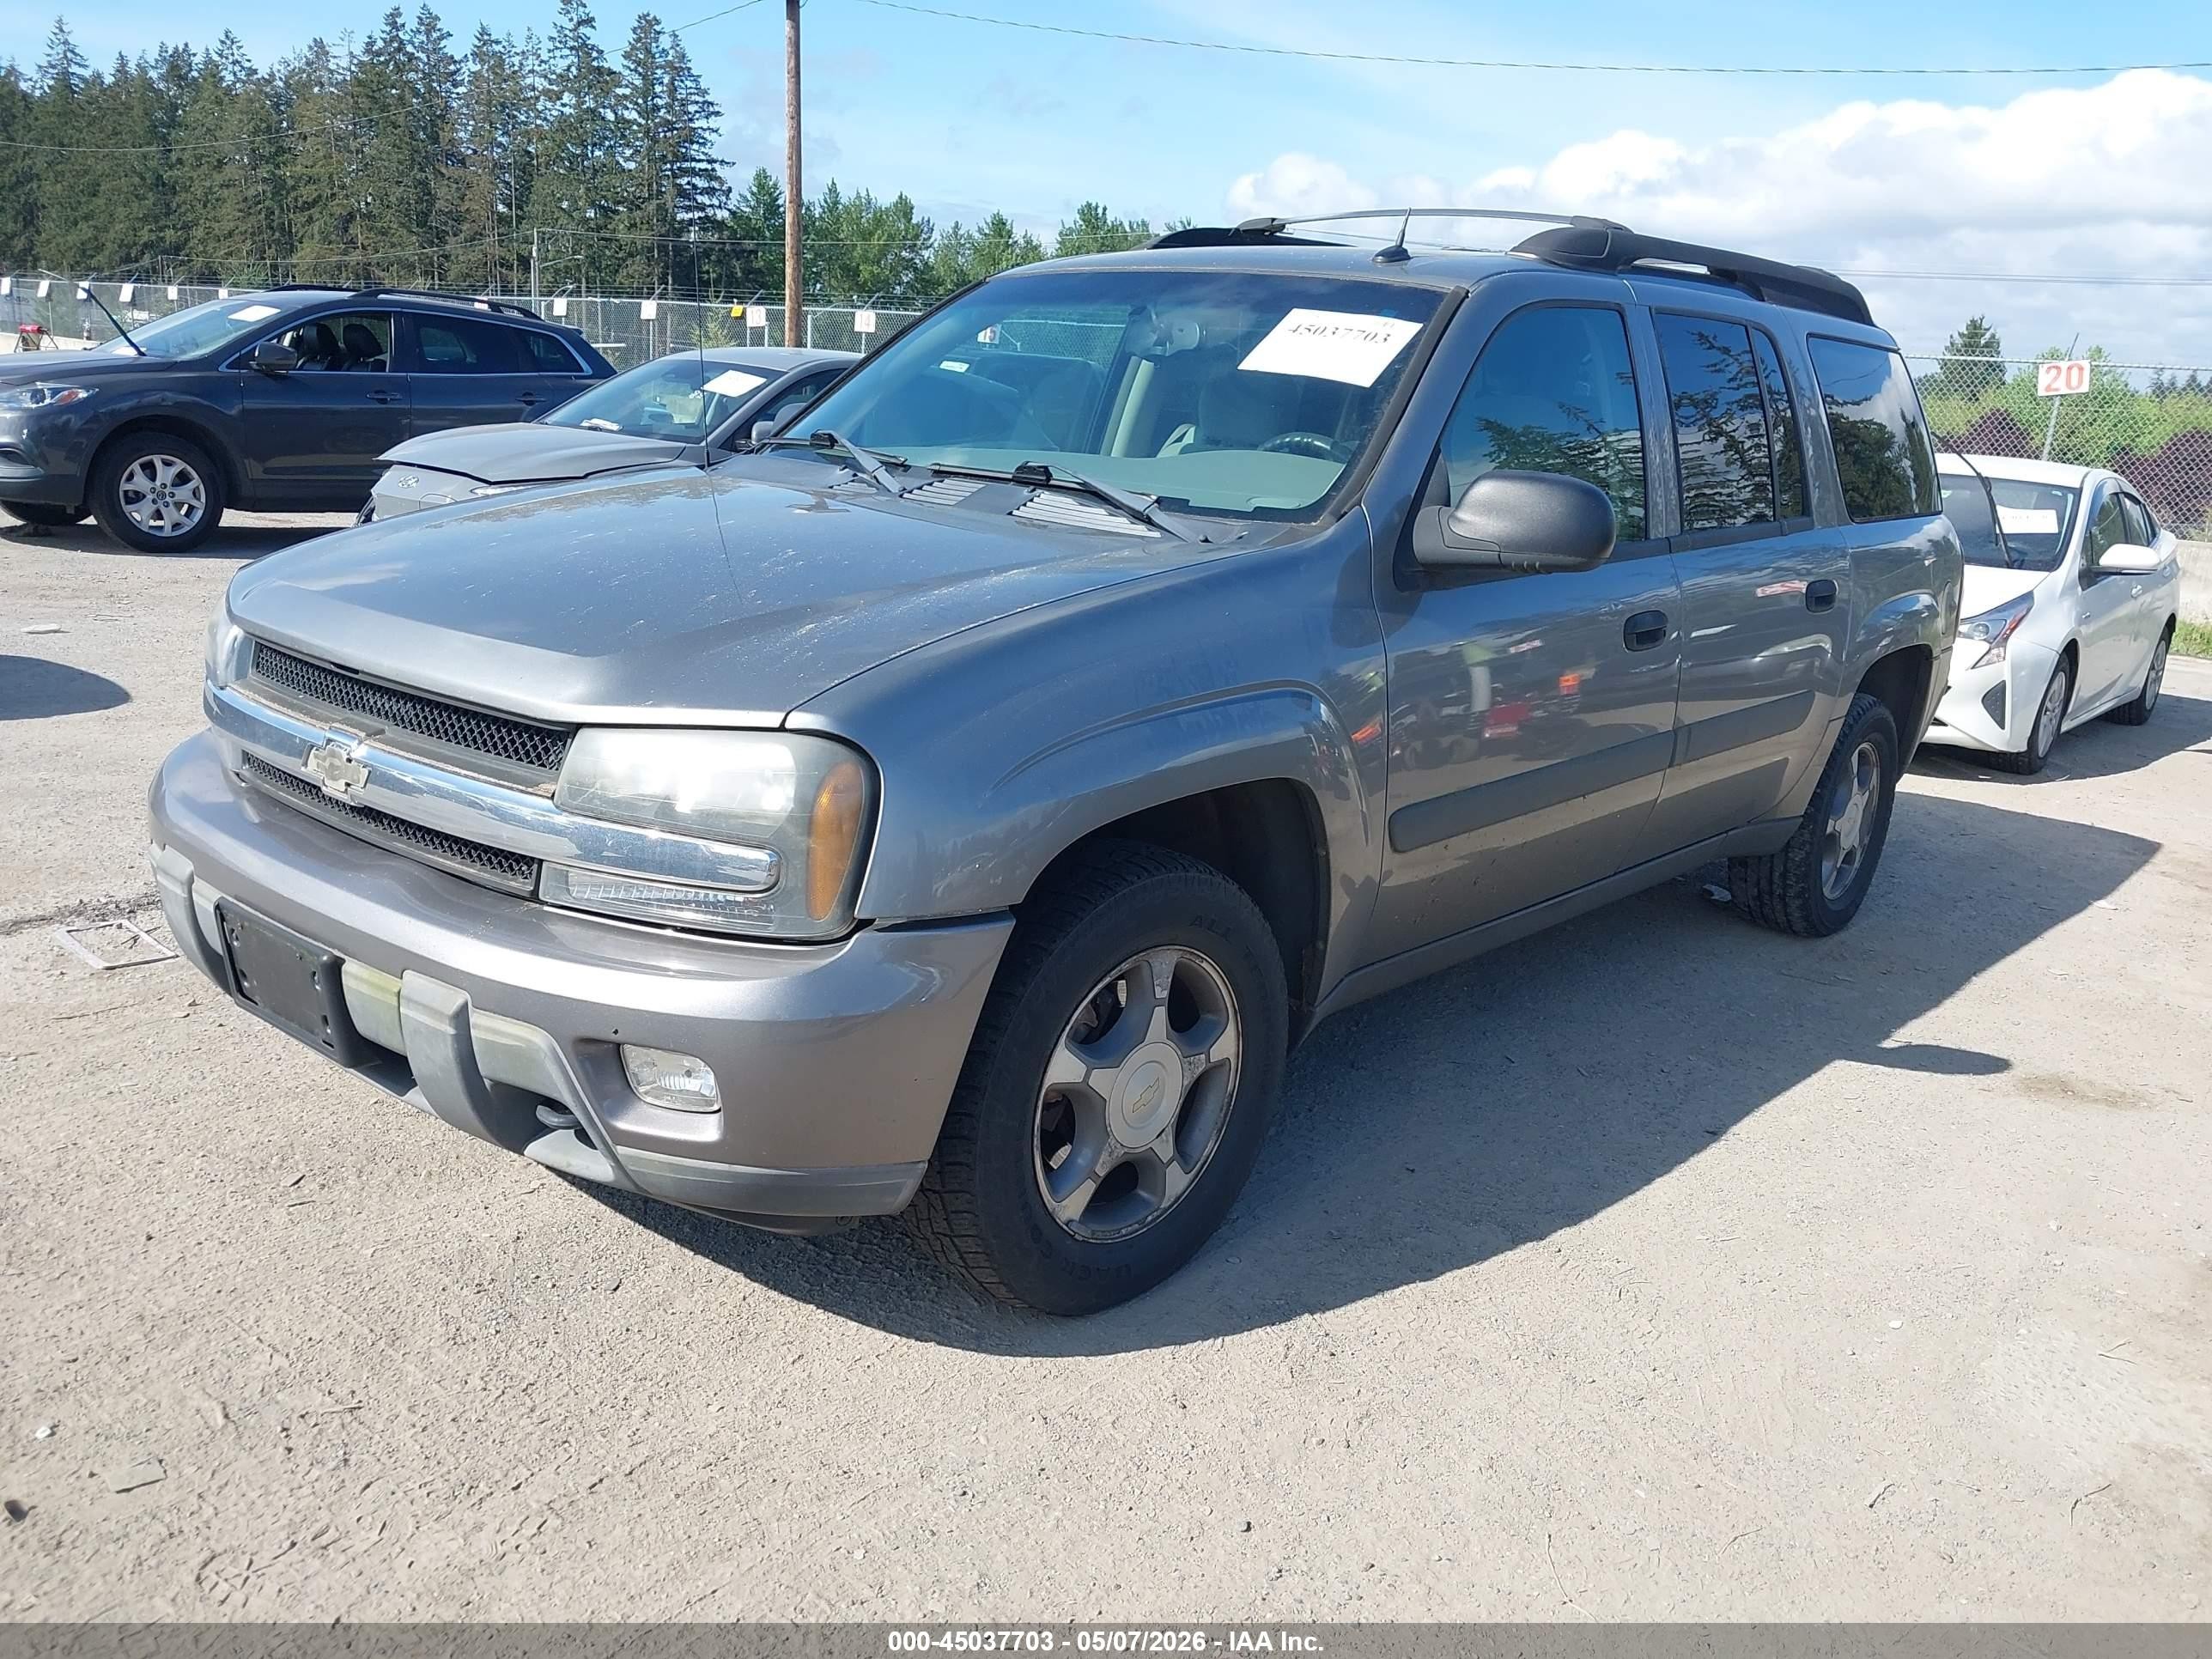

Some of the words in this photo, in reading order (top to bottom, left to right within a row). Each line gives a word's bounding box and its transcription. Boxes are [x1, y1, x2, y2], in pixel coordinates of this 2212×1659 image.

[750, 308, 762, 325] 13
[860, 313, 872, 331] 14
[1288, 323, 1392, 344] 45037703
[2045, 362, 2085, 393] 20
